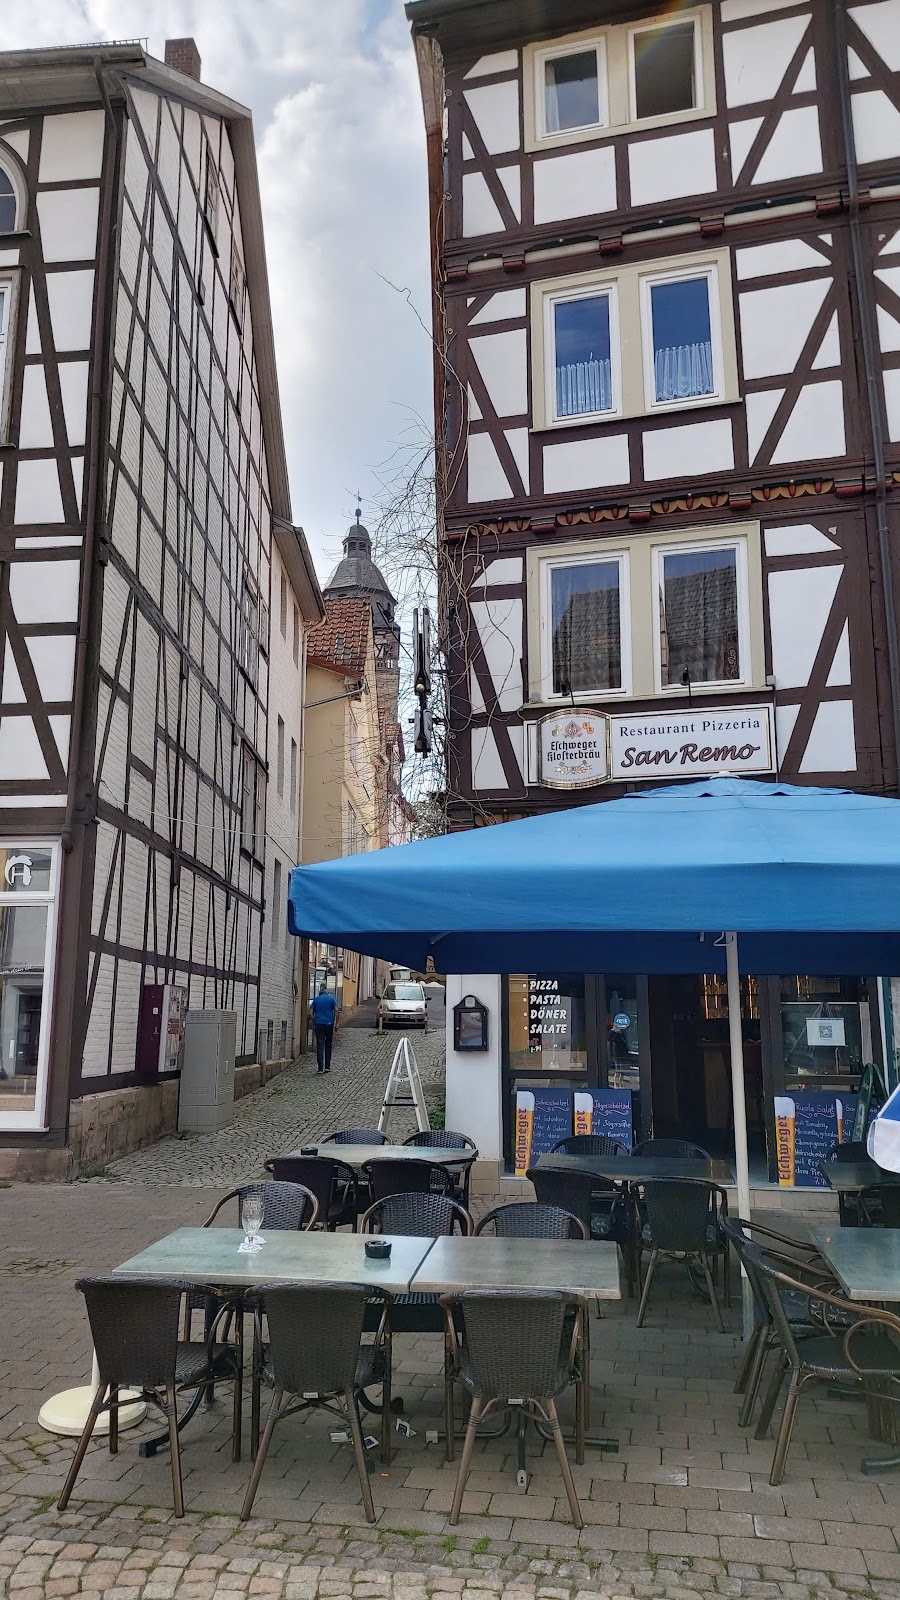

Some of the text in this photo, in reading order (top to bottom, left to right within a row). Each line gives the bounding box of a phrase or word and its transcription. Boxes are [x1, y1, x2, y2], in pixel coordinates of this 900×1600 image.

[620, 718, 761, 737] Restaurant Pizzeria
[620, 742, 760, 768] San Remo
[529, 980, 558, 990] PIZZA
[529, 994, 561, 1005] PASTA
[530, 1007, 567, 1019] DÖNER
[530, 1024, 568, 1034] SALATE
